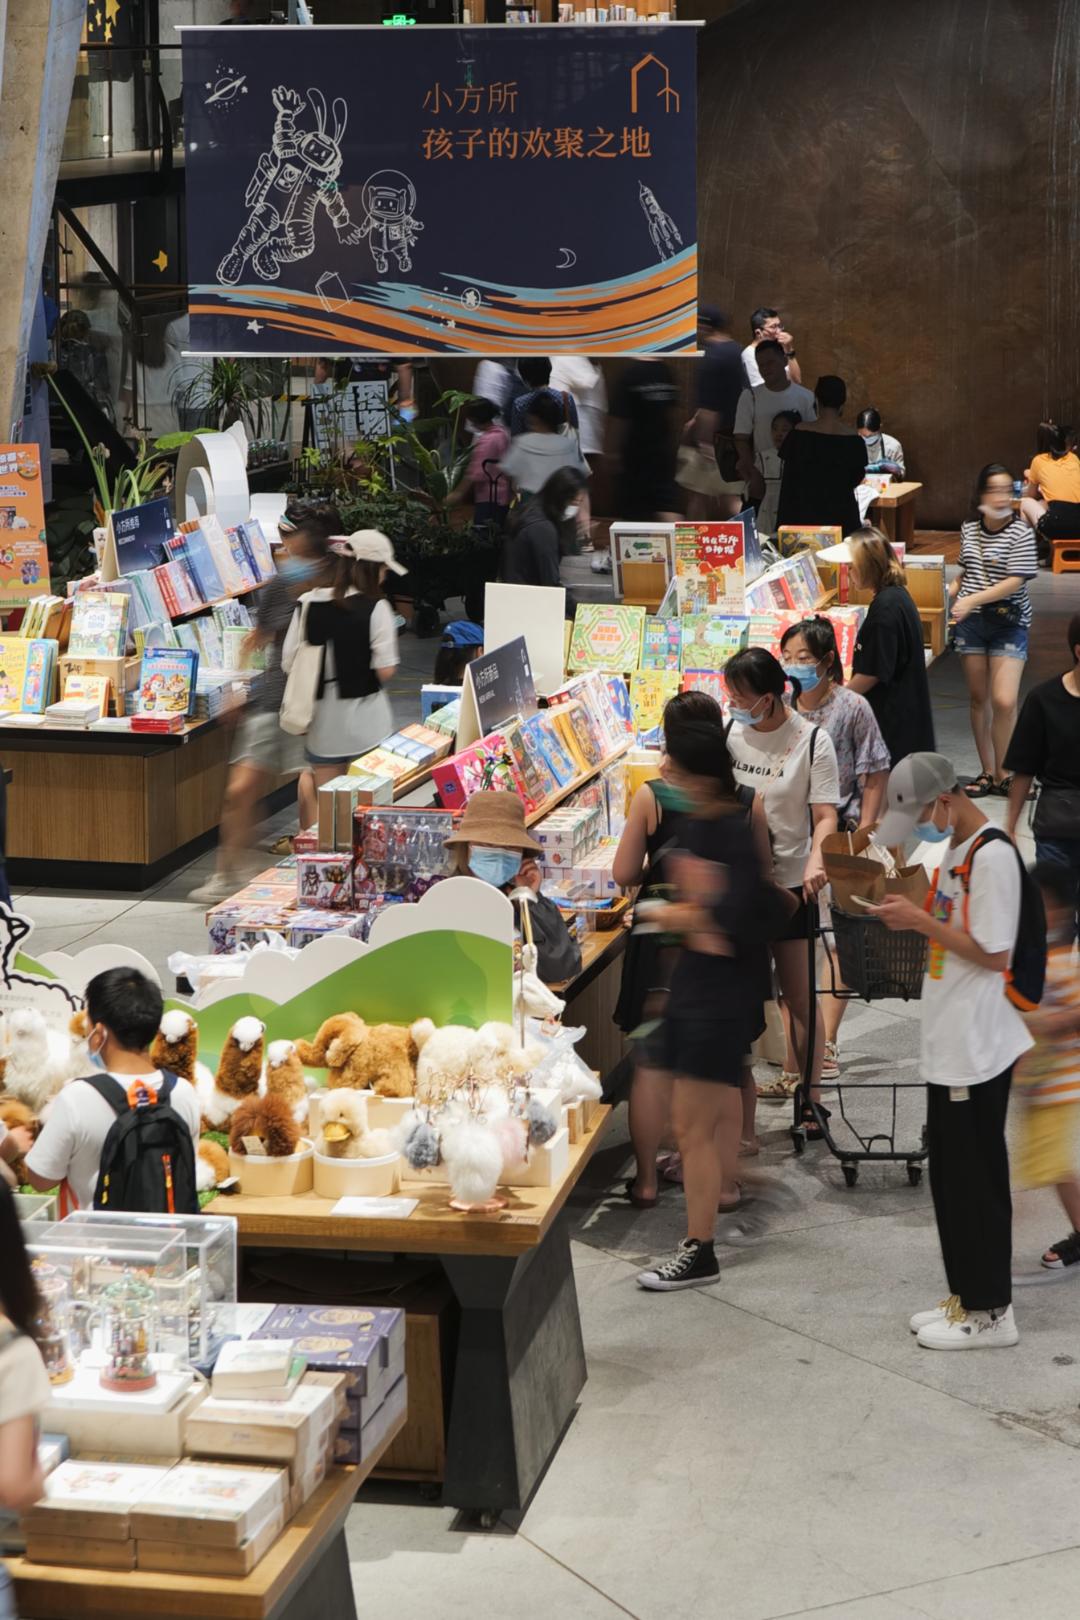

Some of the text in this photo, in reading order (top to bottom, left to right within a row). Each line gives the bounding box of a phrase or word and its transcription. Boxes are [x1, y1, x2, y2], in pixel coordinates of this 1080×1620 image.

[422, 81, 518, 114] 小方所
[422, 126, 652, 161] 孩子的欢聚之地
